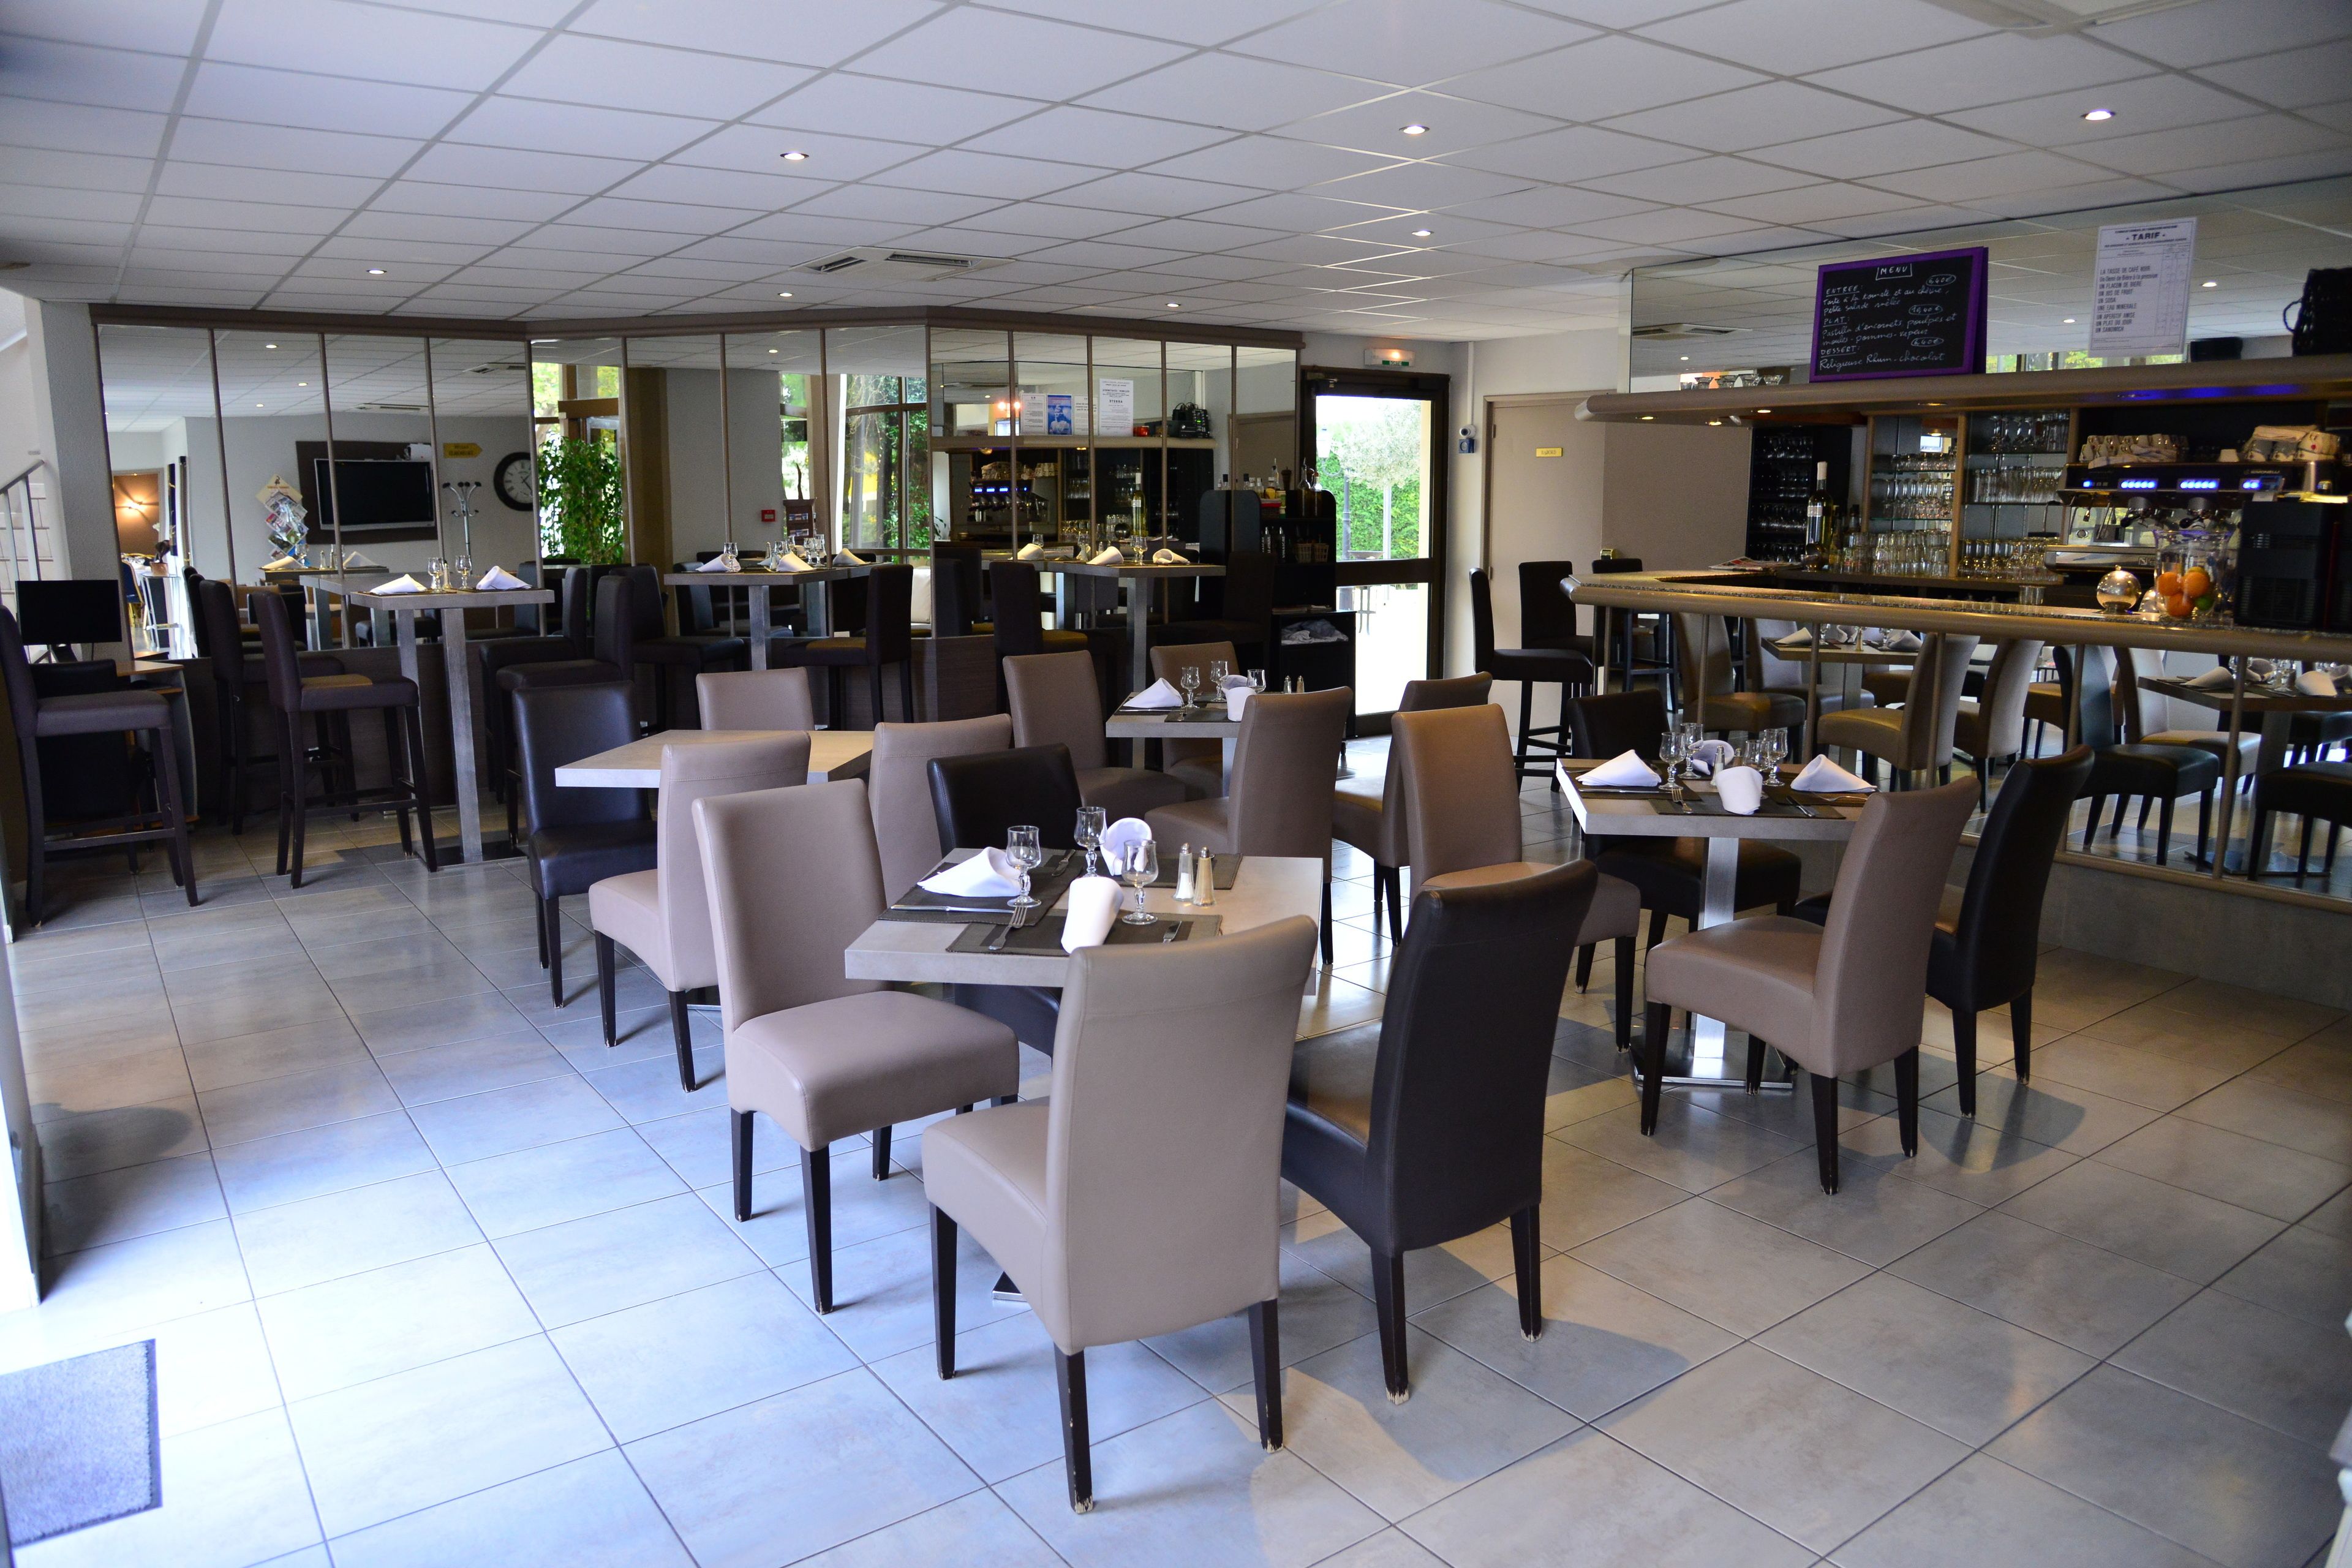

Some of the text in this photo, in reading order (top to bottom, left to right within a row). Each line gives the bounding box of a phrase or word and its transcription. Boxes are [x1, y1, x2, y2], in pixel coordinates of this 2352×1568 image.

[2132, 232, 2160, 241] TARIF
[1880, 266, 1908, 275] MENU
[1850, 293, 1860, 303] la
[1845, 301, 1869, 312] salade
[1945, 313, 1957, 322] et
[1822, 334, 1848, 346] moules
